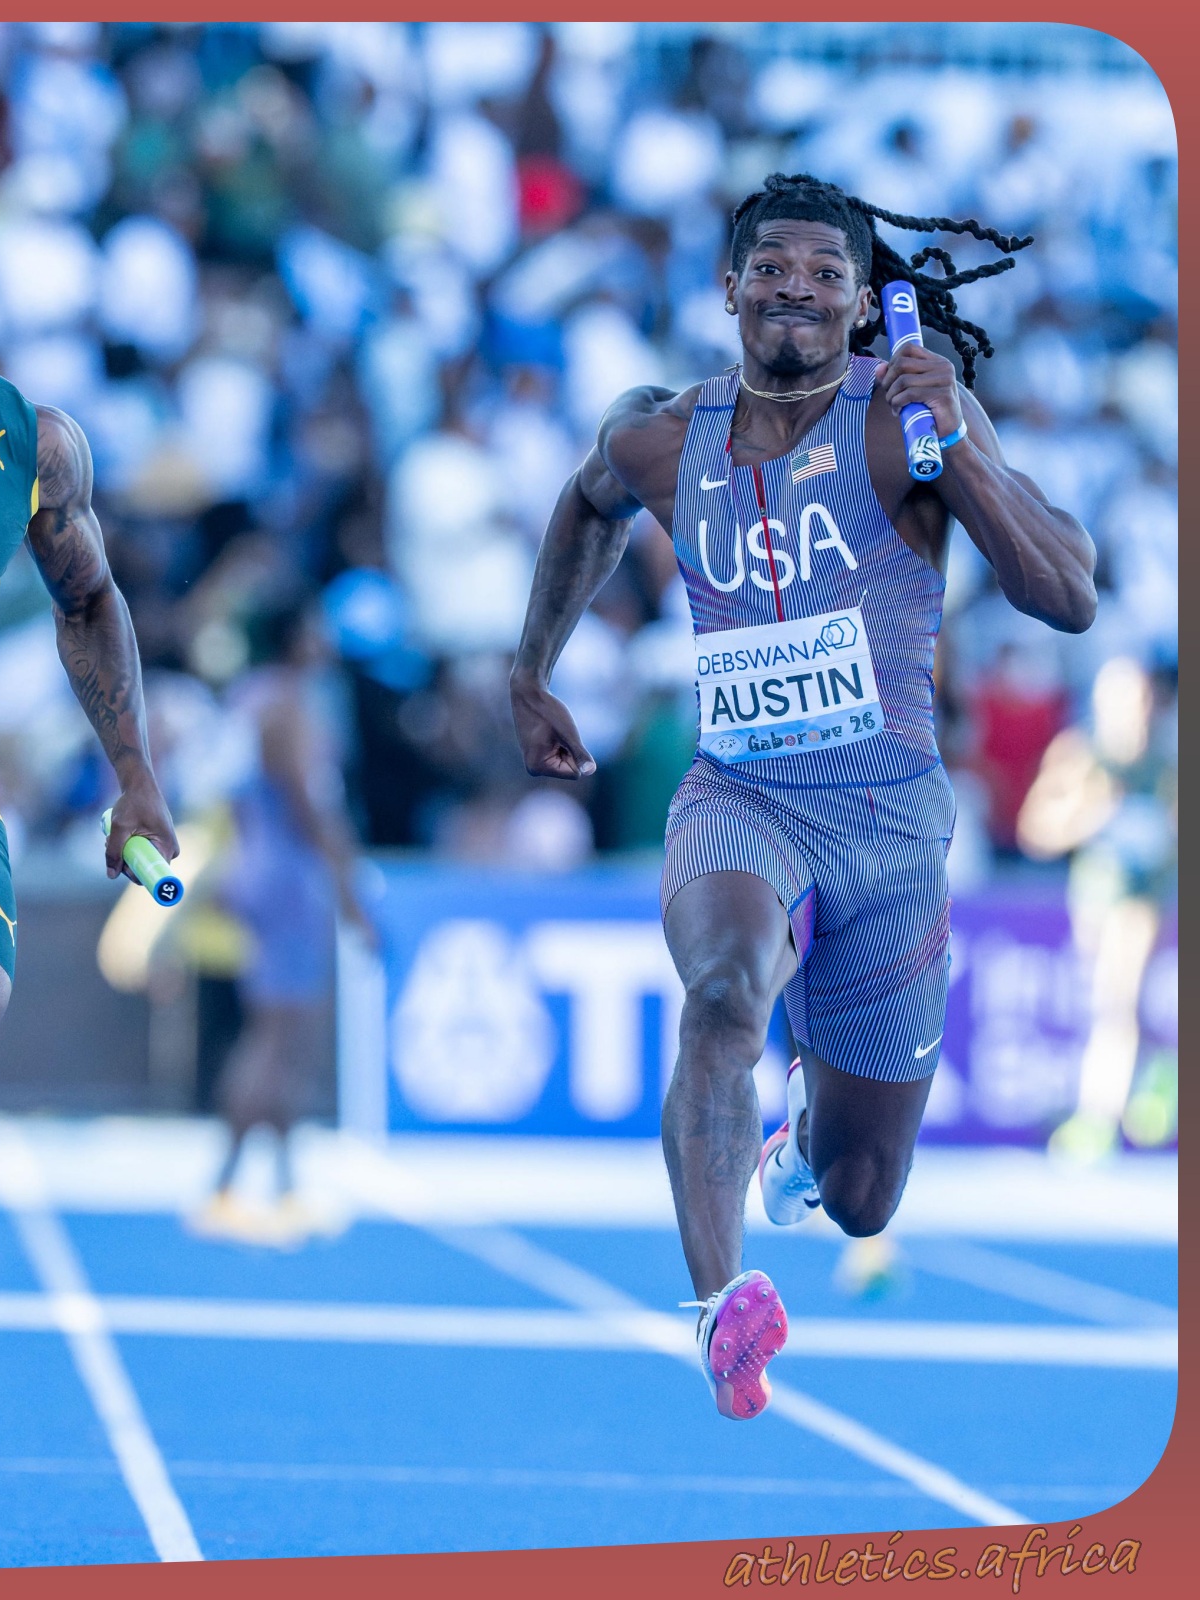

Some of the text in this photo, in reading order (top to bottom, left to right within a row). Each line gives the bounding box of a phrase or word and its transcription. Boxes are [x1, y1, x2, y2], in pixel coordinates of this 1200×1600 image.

[920, 461, 934, 474] 36
[699, 502, 858, 592] USA
[697, 638, 830, 676] DEBSWANA
[711, 662, 864, 726] AUSTIN
[747, 711, 876, 753] Gaborone 26
[161, 883, 175, 900] 37
